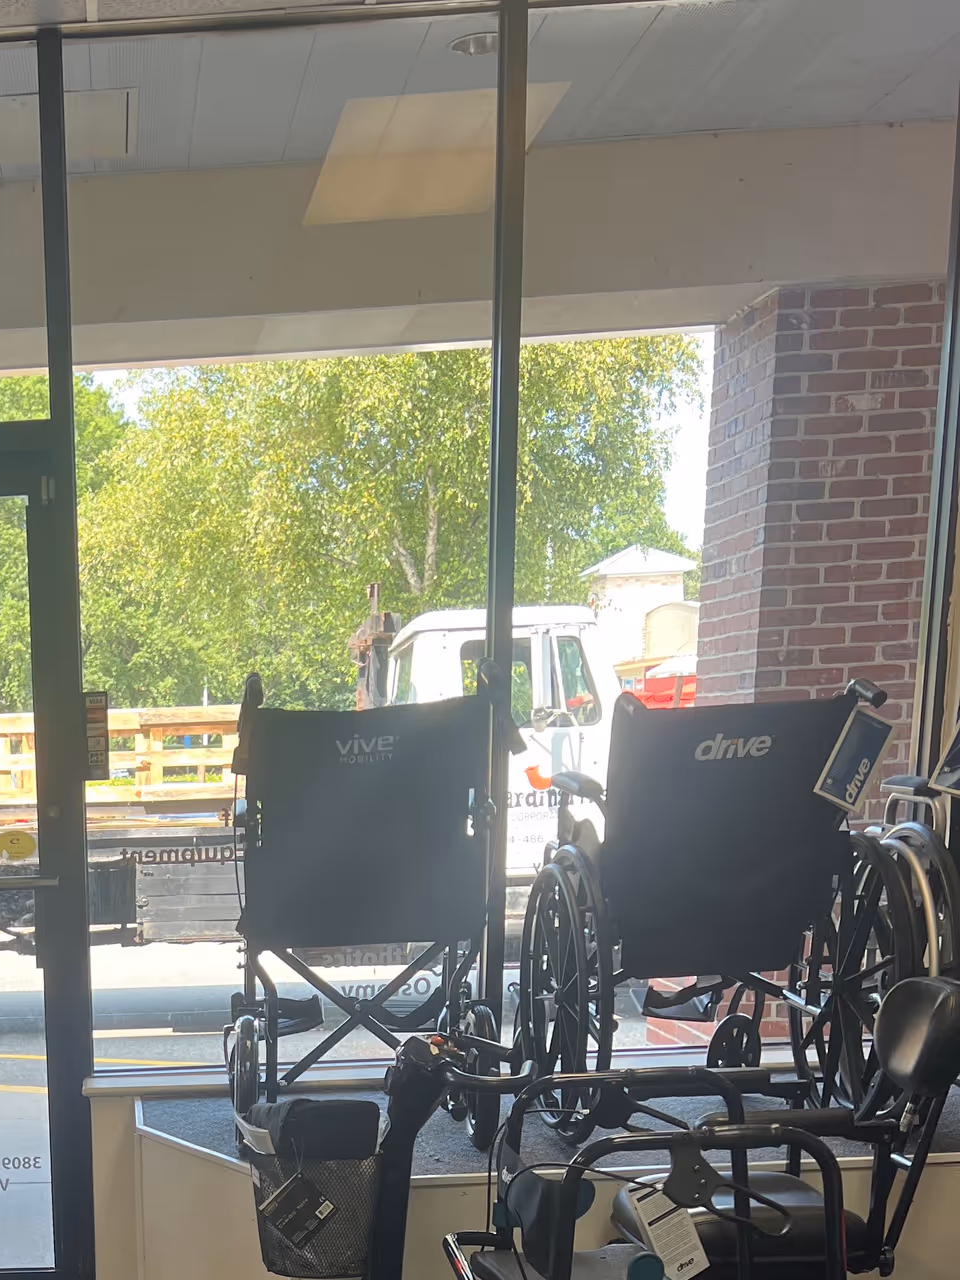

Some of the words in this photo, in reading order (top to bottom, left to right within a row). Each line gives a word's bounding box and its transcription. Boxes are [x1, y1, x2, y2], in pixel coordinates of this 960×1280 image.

[336, 734, 394, 755] vive
[694, 733, 772, 762] drive
[340, 752, 393, 764] MOBILITY
[845, 757, 871, 804] drive
